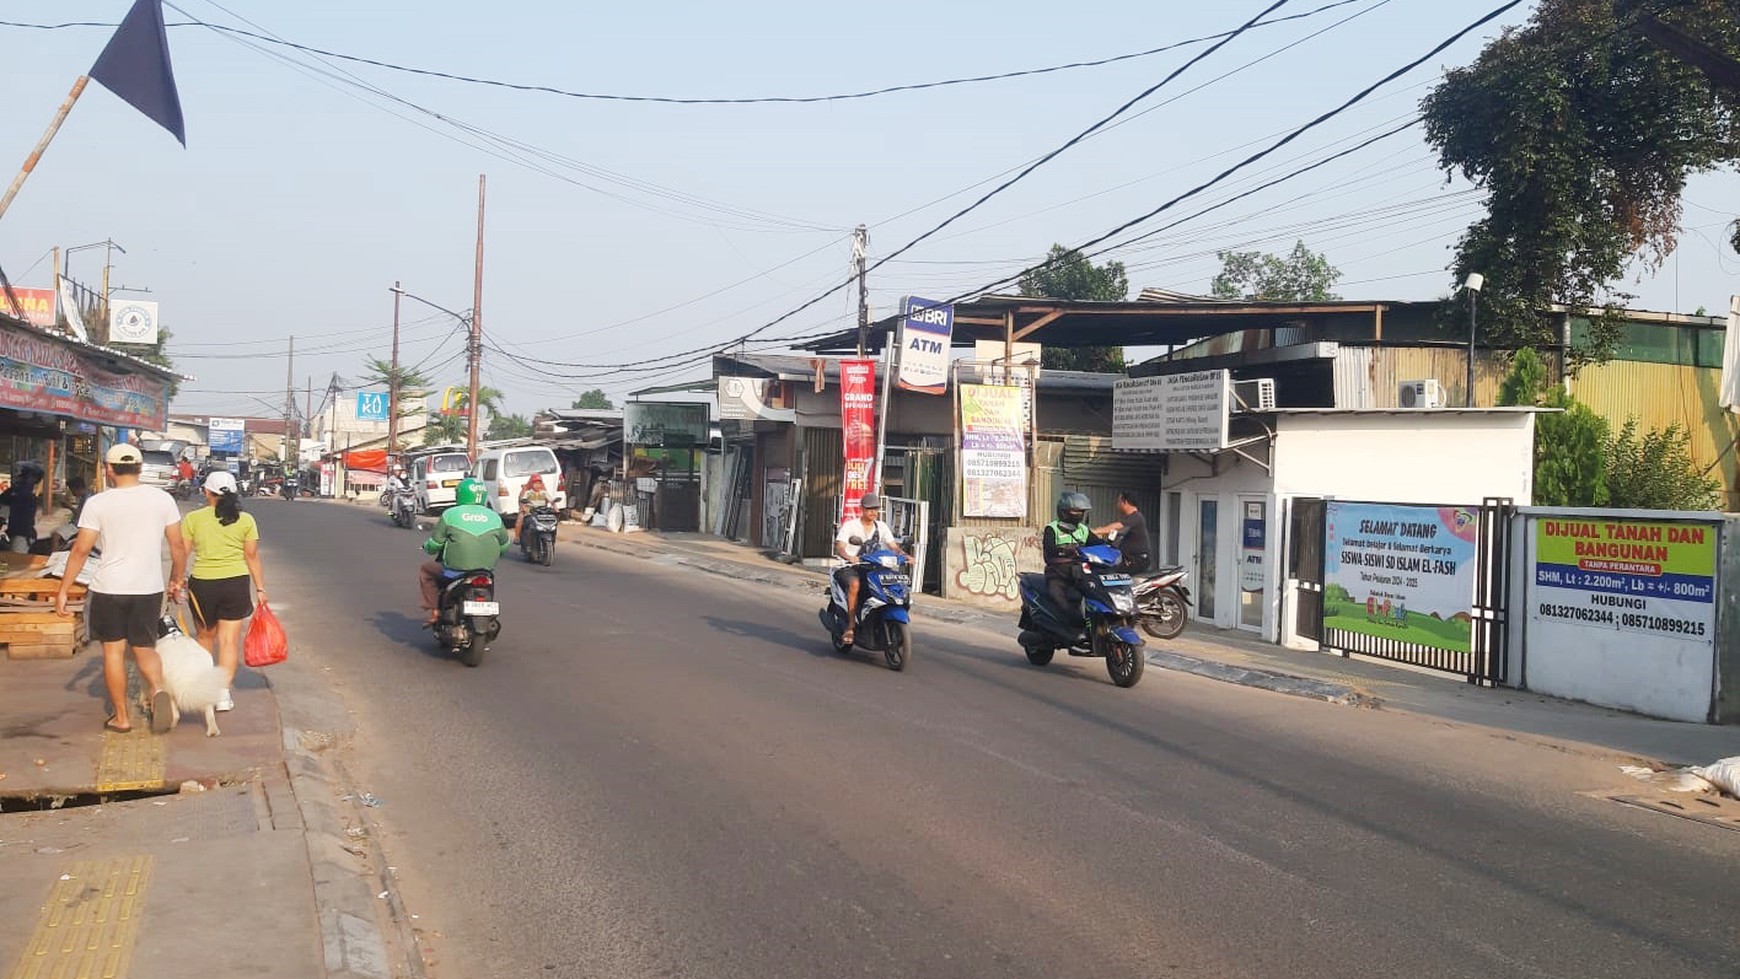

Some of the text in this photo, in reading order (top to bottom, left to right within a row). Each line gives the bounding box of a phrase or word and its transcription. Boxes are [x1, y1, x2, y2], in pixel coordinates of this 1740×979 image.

[924, 307, 948, 326] BRI
[909, 337, 943, 355] ATM
[844, 392, 874, 402] GRAND
[976, 451, 1011, 460] HUBUNGI
[461, 512, 489, 523] Grab
[1358, 519, 1438, 539] SELAMAT DATANG
[1545, 521, 1705, 545] DIJUAL TANAH DAN
[1419, 543, 1452, 556] Berkarya
[1574, 541, 1668, 562] BANGUNAN
[1340, 550, 1457, 576] SISWA-SISWI SD ISLAM EL-FASH
[1583, 559, 1656, 574] TANPA PERANTARA
[1538, 570, 1563, 586] SHM,
[1565, 573, 1576, 585] Lt
[1631, 579, 1646, 591] Lb
[1673, 582, 1711, 598] 800m²
[1590, 593, 1647, 611] HUBUNGI
[1539, 602, 1614, 624] 081327062344
[1621, 612, 1706, 636] 085710899215
